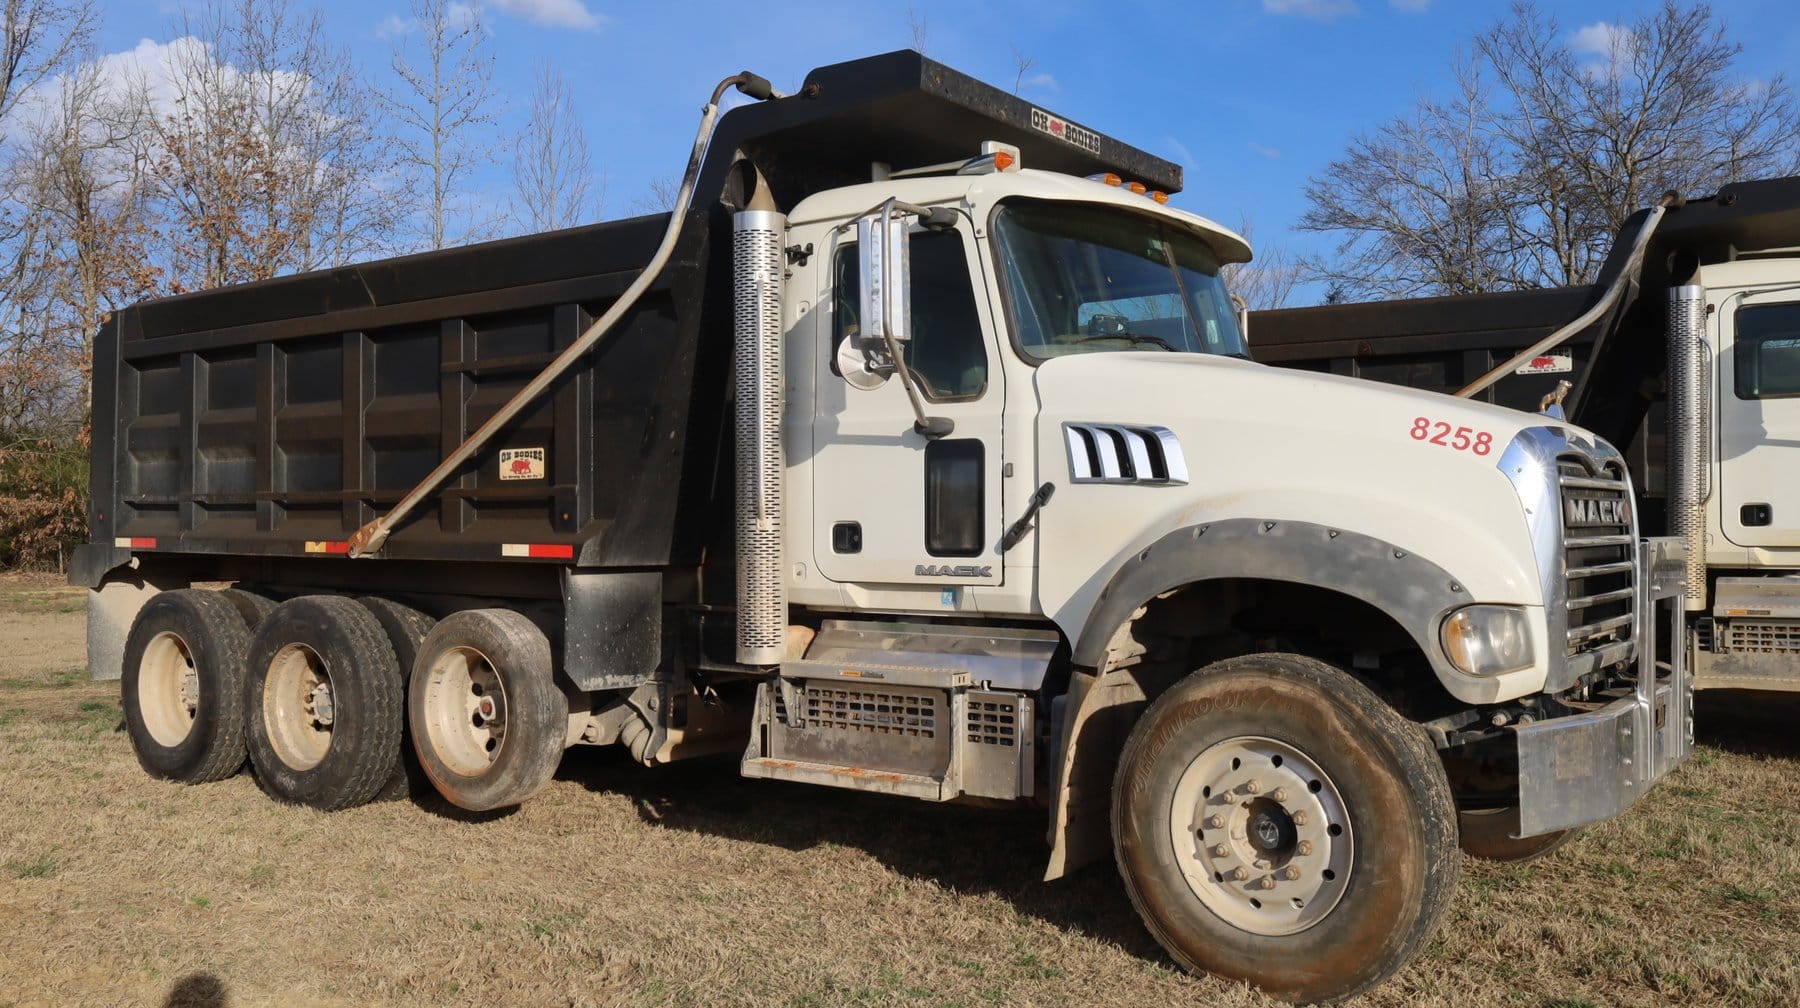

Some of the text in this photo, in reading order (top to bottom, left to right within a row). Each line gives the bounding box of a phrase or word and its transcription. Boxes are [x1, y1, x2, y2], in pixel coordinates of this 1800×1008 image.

[1032, 110, 1099, 153] OX BODIES
[1410, 416, 1493, 456] 8258
[514, 450, 543, 461] BODIES
[1568, 499, 1628, 523] MACK
[915, 564, 992, 577] MACK
